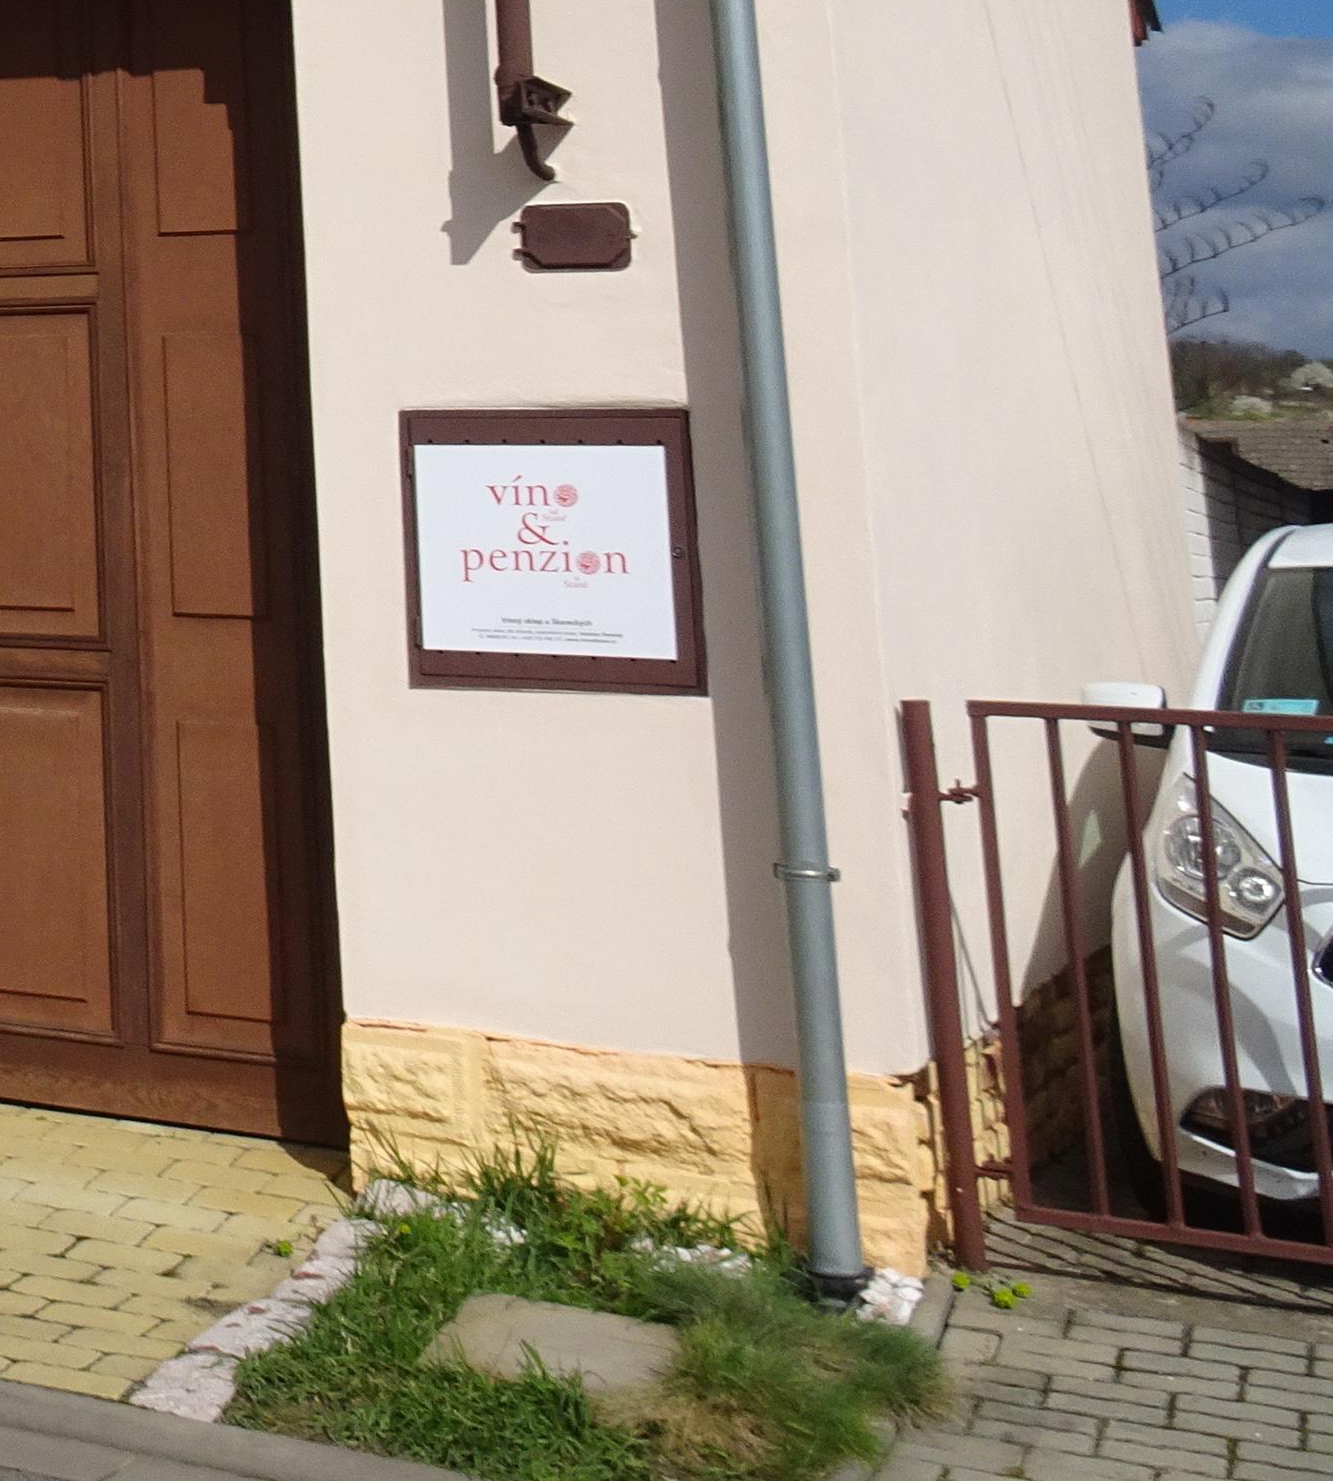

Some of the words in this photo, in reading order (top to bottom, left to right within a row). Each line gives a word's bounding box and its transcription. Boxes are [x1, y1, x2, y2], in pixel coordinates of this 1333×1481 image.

[486, 475, 579, 507] víno
[517, 512, 560, 545] &
[460, 540, 630, 582] penzion
